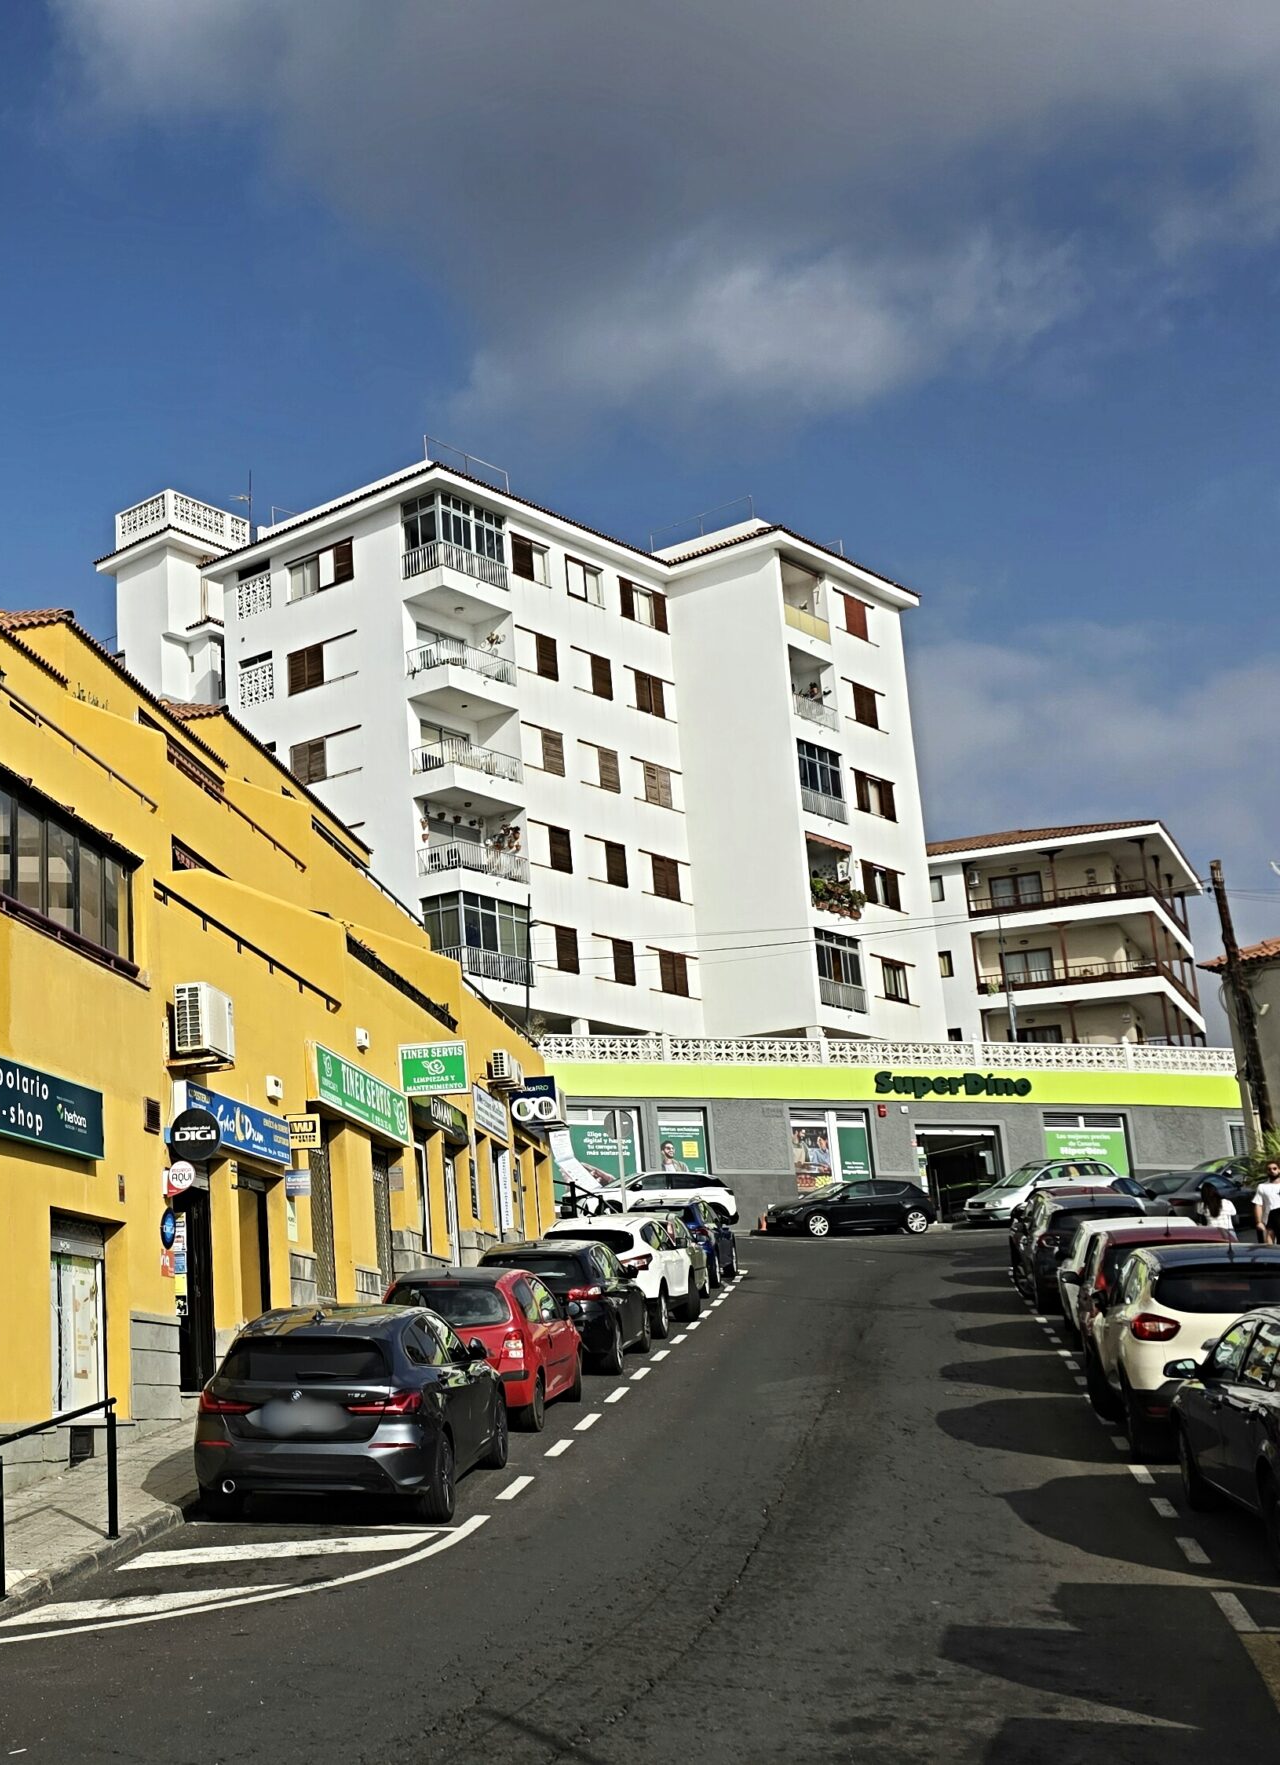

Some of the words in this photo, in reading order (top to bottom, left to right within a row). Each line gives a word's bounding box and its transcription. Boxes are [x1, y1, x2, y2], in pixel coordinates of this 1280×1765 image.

[402, 1048, 429, 1060] TINER
[431, 1046, 463, 1057] SERVIS
[341, 1062, 365, 1103] TINER
[366, 1078, 392, 1118] SERVIS
[406, 1083, 463, 1092] MANTENIMIENTO
[174, 1129, 217, 1142] DIGI
